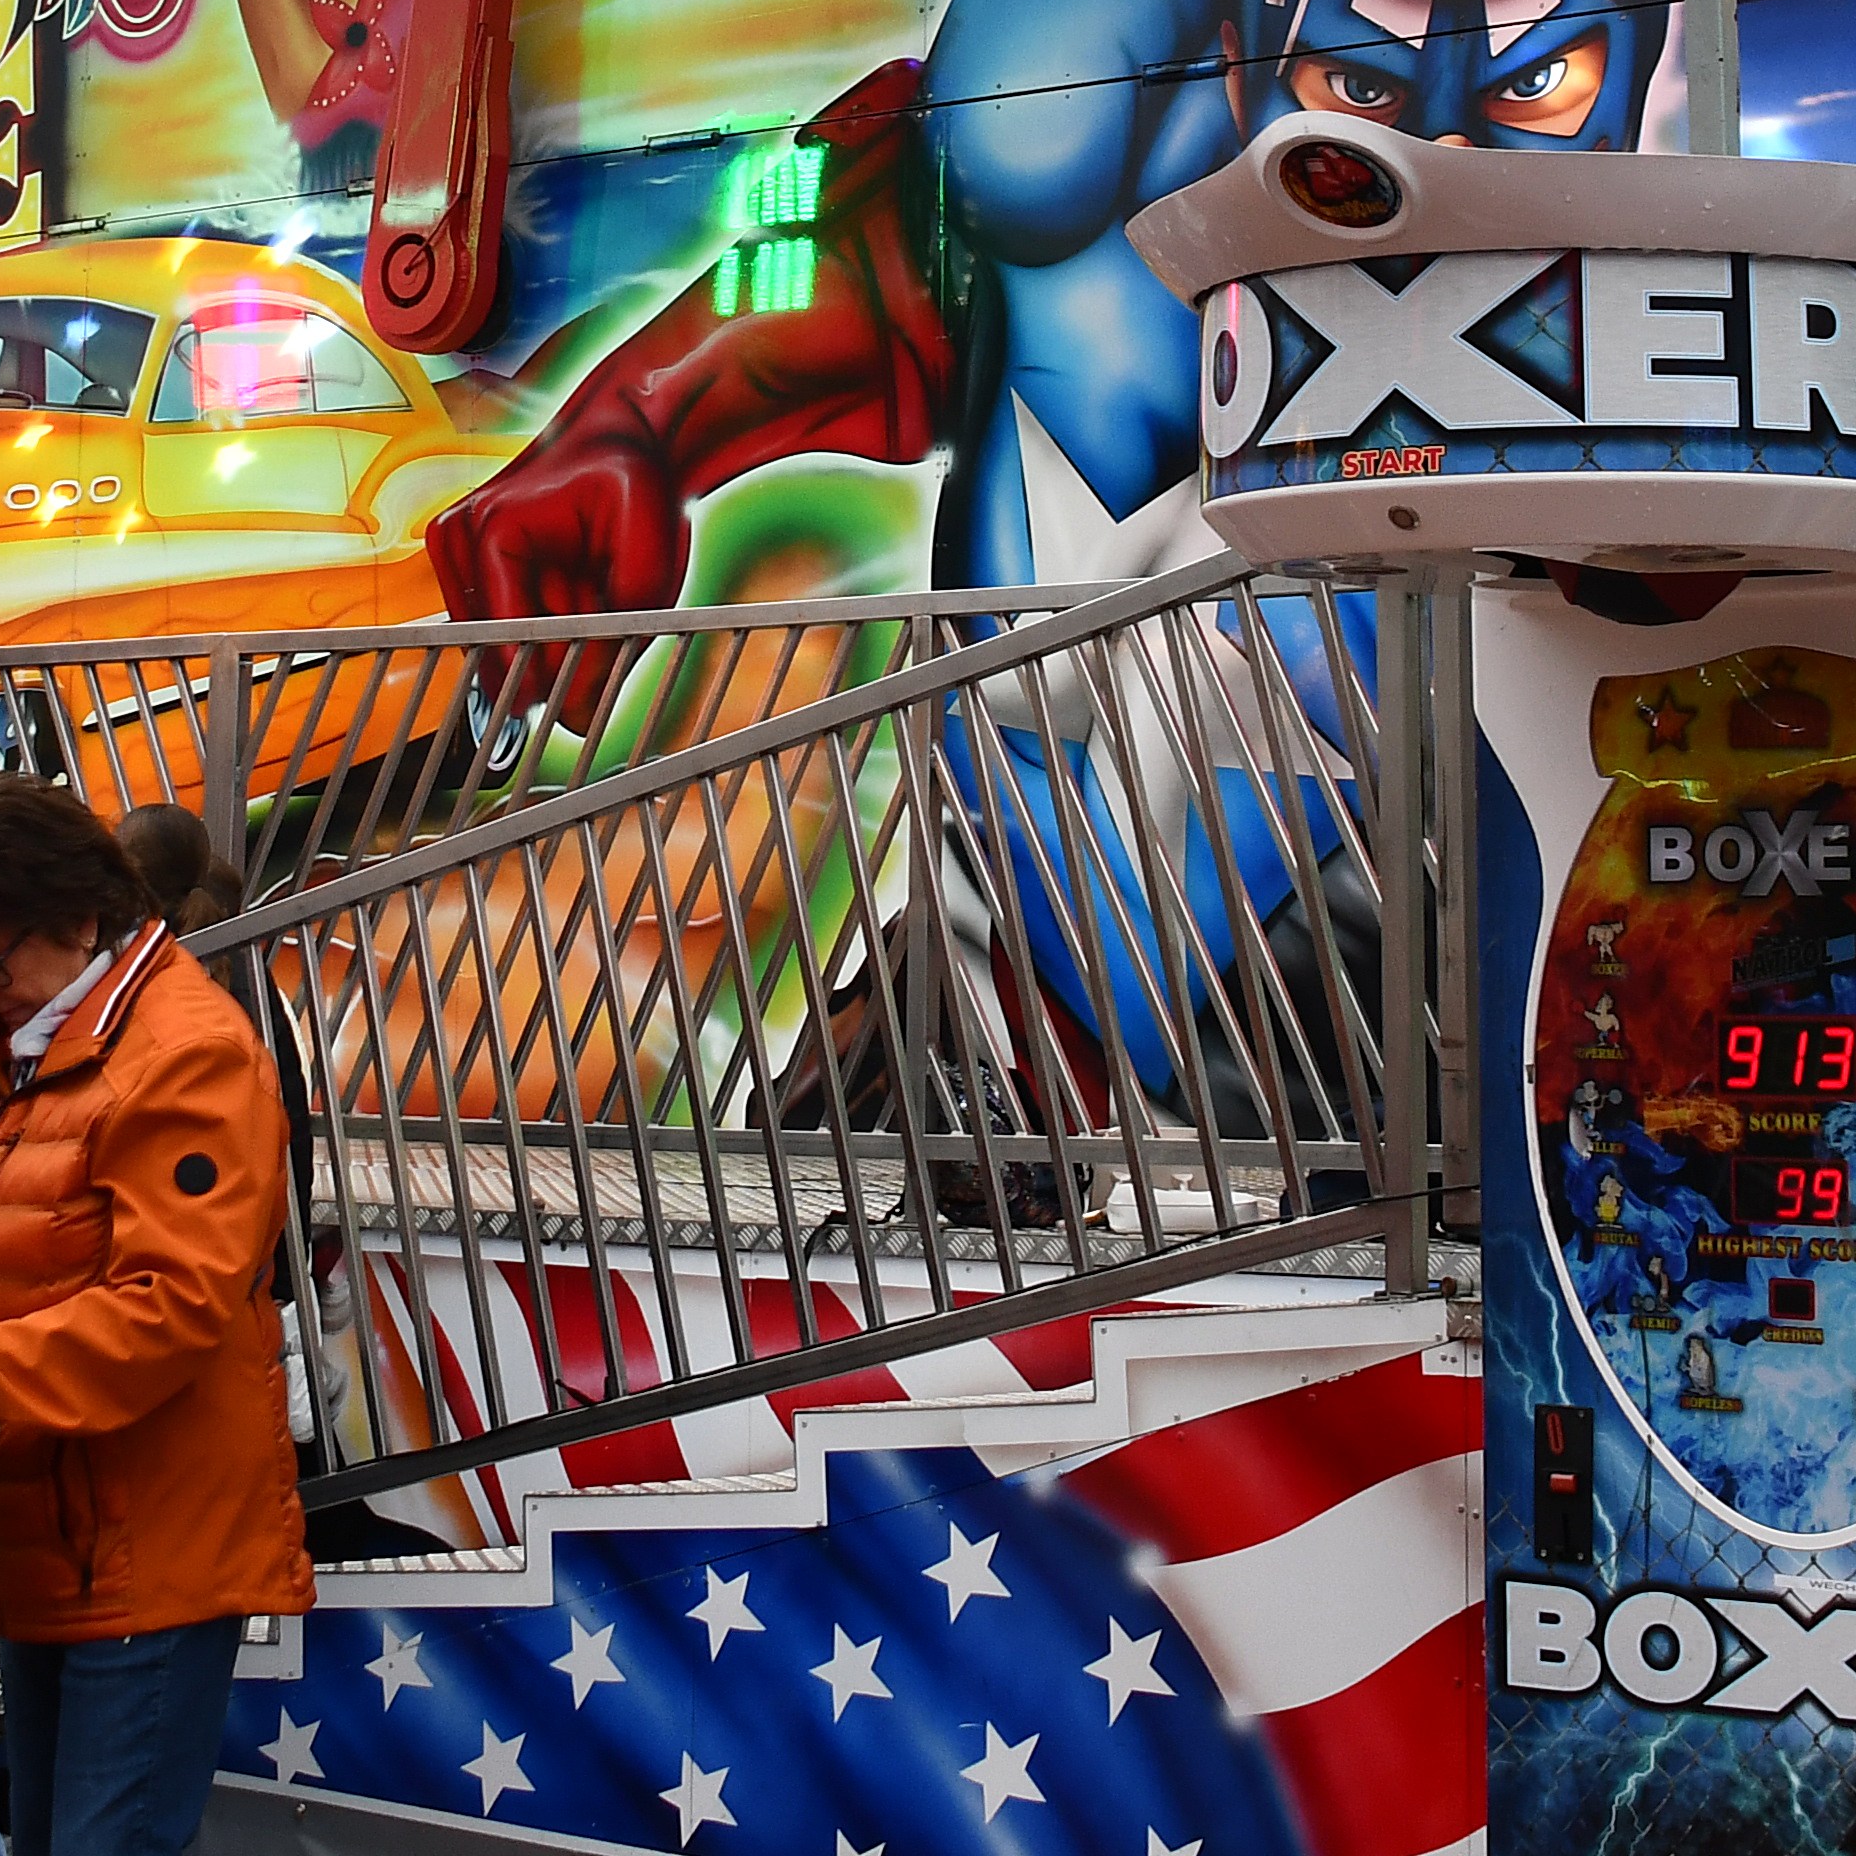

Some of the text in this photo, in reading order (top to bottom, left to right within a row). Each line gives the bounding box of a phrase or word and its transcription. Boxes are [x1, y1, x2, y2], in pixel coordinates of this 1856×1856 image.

[1343, 444, 1445, 478] START
[1727, 1026, 1855, 1090] 913
[1749, 1112, 1823, 1133] SCORE
[1776, 1167, 1843, 1220] 99
[1697, 1235, 1803, 1259] HIGHEST
